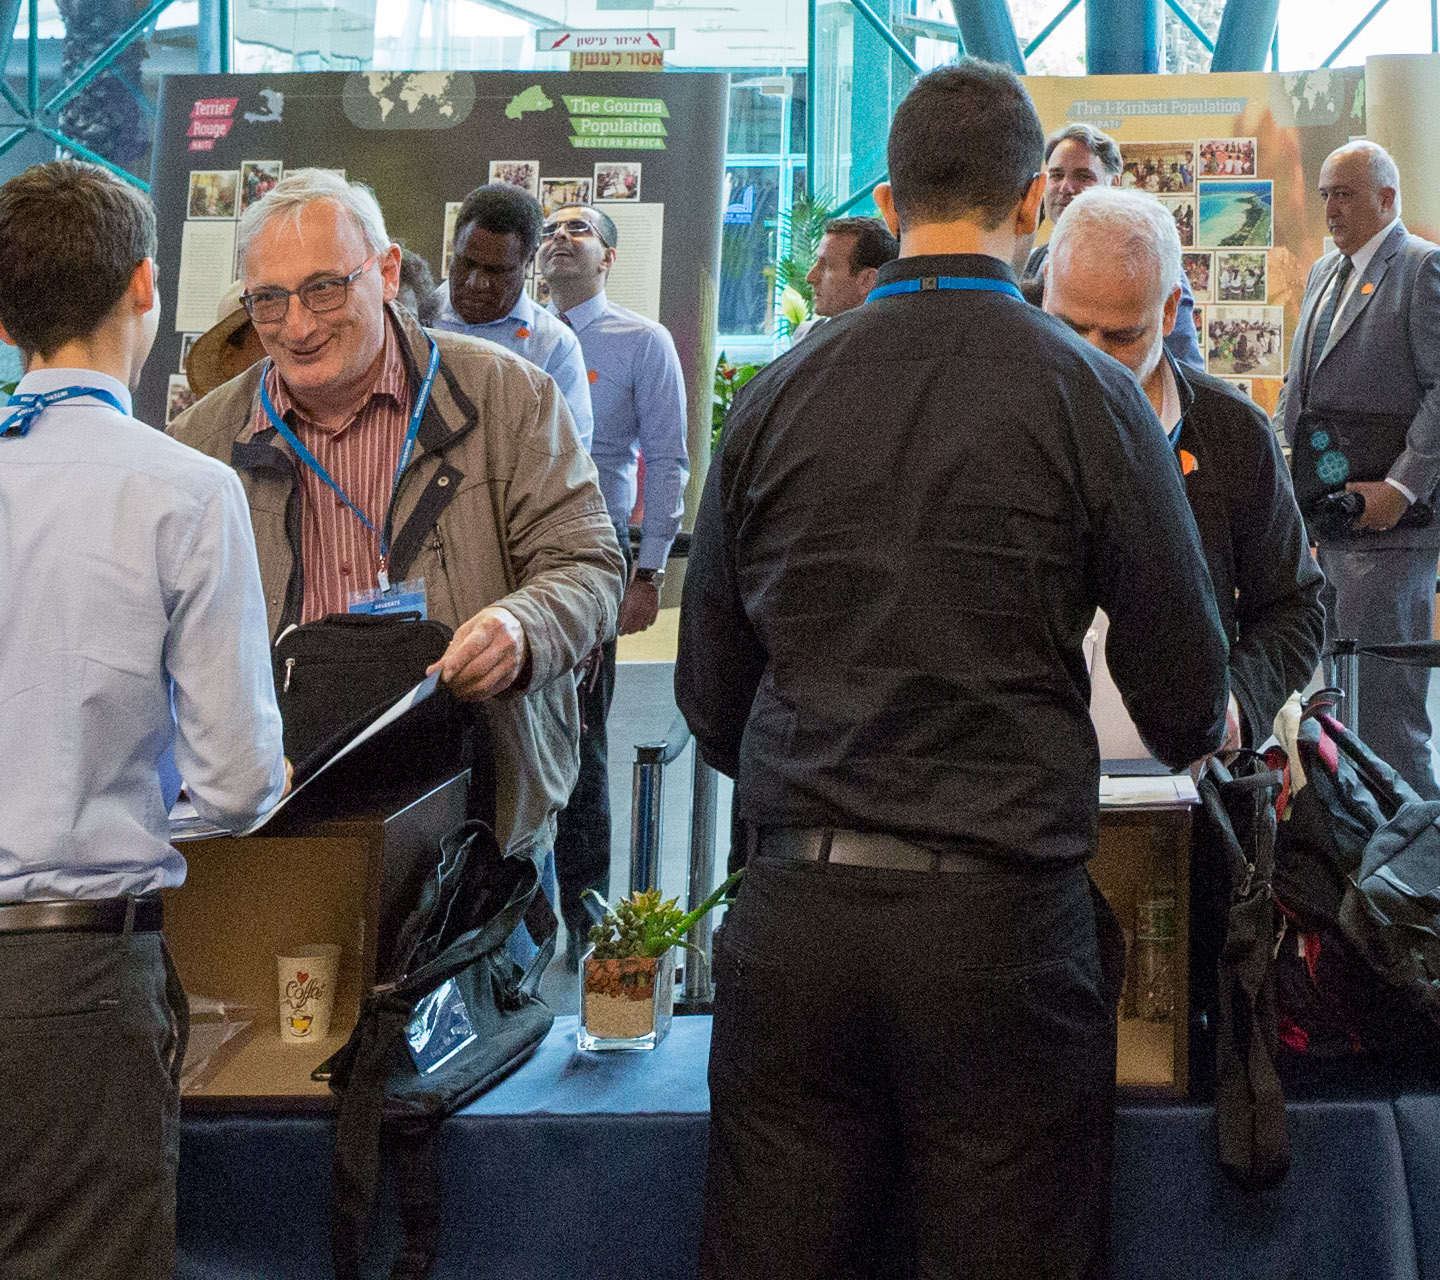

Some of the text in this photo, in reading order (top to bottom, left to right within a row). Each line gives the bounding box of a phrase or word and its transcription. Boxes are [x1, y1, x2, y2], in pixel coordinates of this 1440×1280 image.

[194, 101, 230, 116] Terrier
[570, 99, 662, 113] The Gourma
[1074, 102, 1104, 114] The
[1171, 99, 1242, 116] Population
[193, 121, 227, 138] Rouge
[580, 118, 662, 136] Population
[574, 138, 661, 147] WESTERN AFRICA
